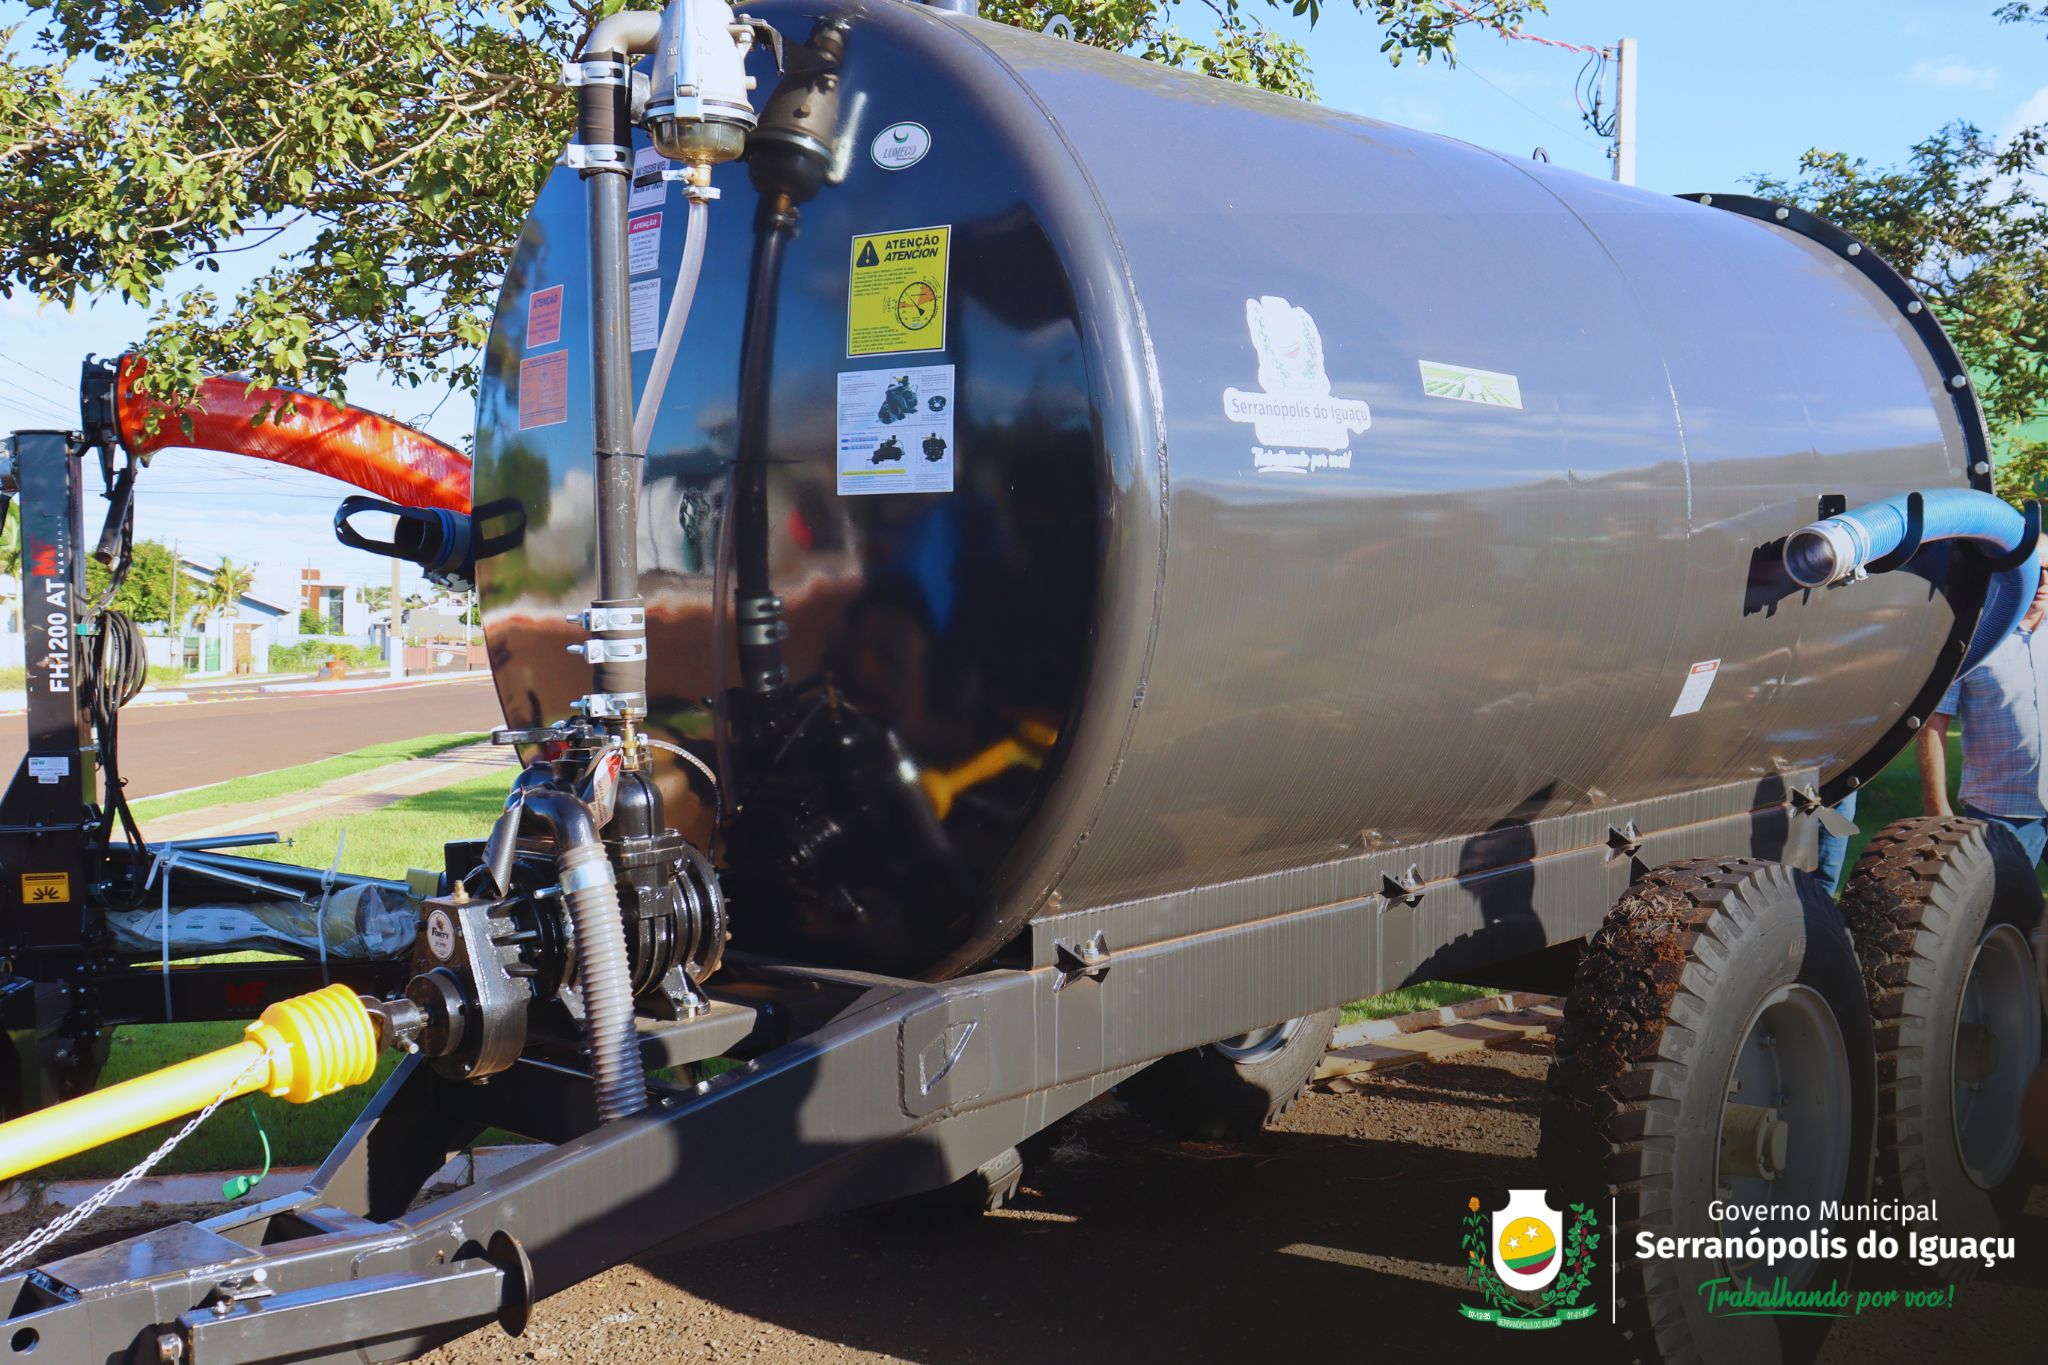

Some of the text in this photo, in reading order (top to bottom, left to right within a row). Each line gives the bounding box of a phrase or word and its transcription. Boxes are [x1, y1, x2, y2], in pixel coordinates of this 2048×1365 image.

[632, 218, 657, 231] ATENÇÃO
[884, 233, 940, 250] ATENÇÃO
[883, 247, 939, 263] ATENCION
[1231, 398, 1368, 426] Serranópolis do Iguaçu
[31, 532, 57, 577] MF
[45, 578, 67, 608] AT
